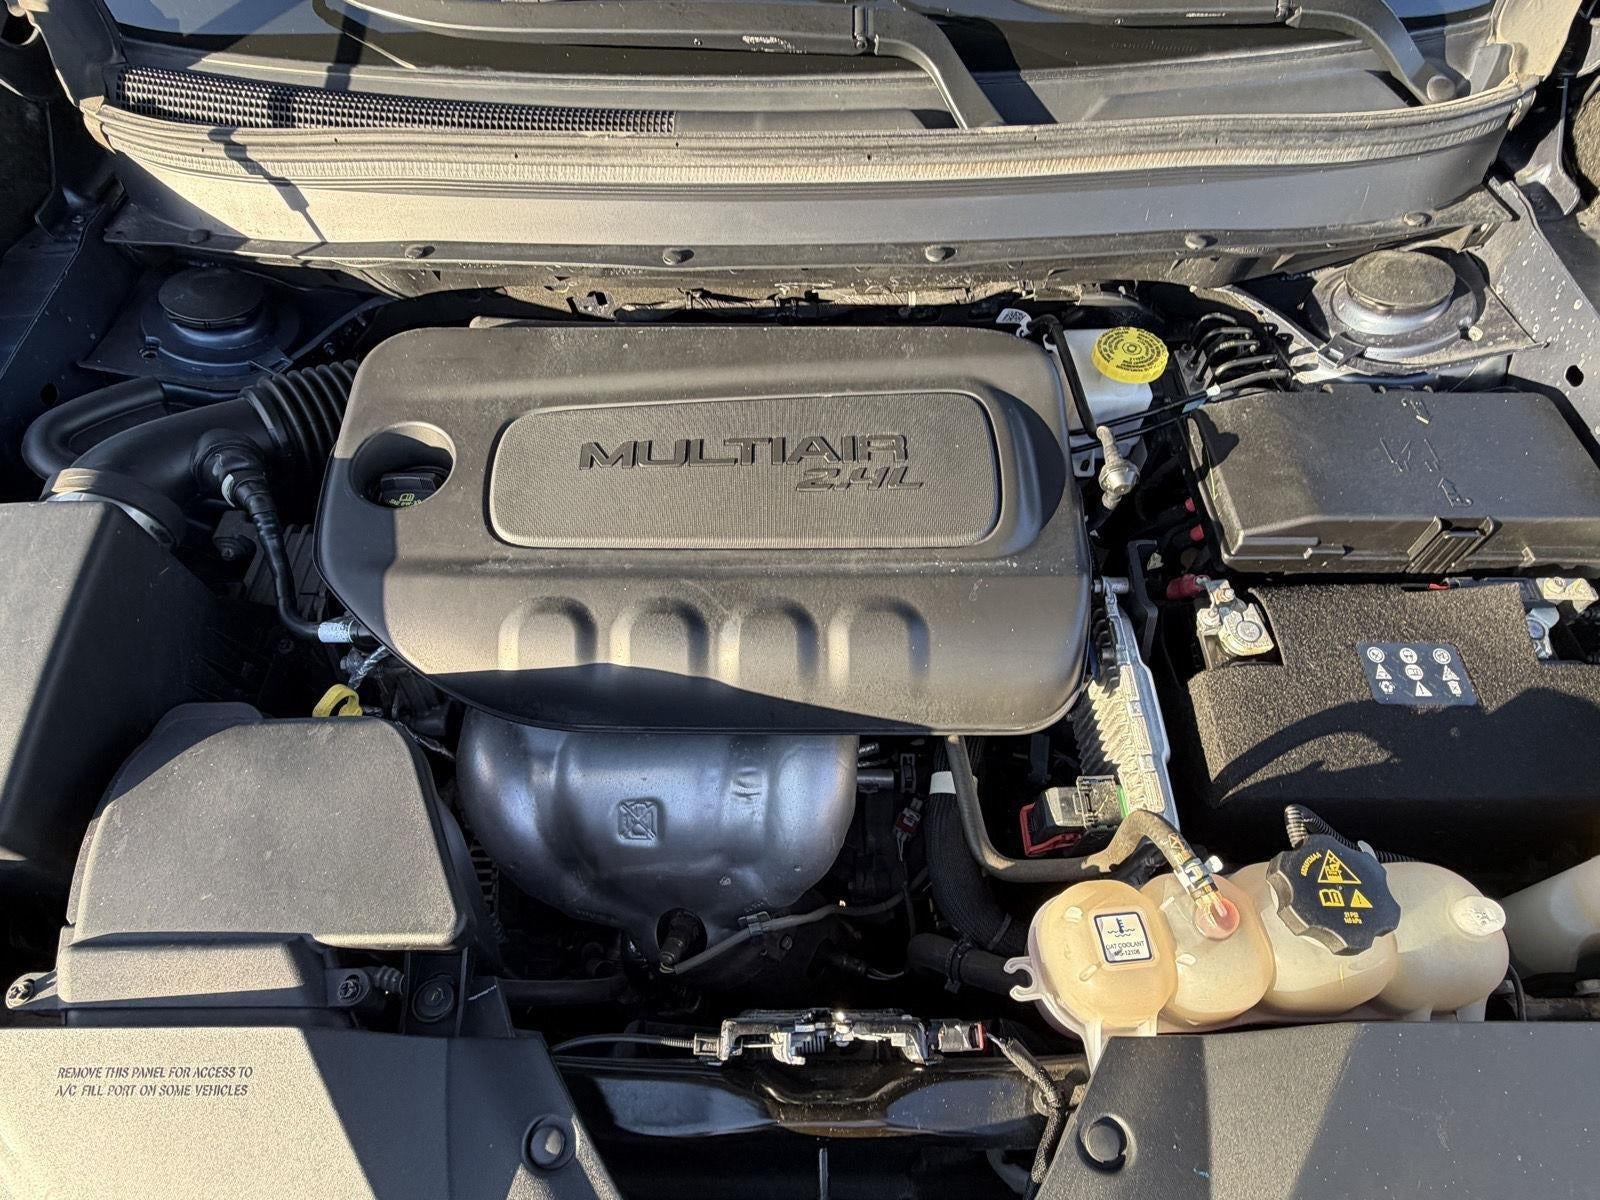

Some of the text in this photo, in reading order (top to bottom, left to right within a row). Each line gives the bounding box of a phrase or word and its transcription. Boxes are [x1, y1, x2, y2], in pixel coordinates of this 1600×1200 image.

[579, 434, 908, 470] MULTIAIR
[795, 465, 924, 492] 2.4L
[1117, 940, 1145, 949] COOLANT
[57, 1066, 253, 1079] REMOVE THIS PANEL FOR ACCESS TO
[55, 1084, 248, 1098] A/C FILL PORT ON SOME VEHICLES
